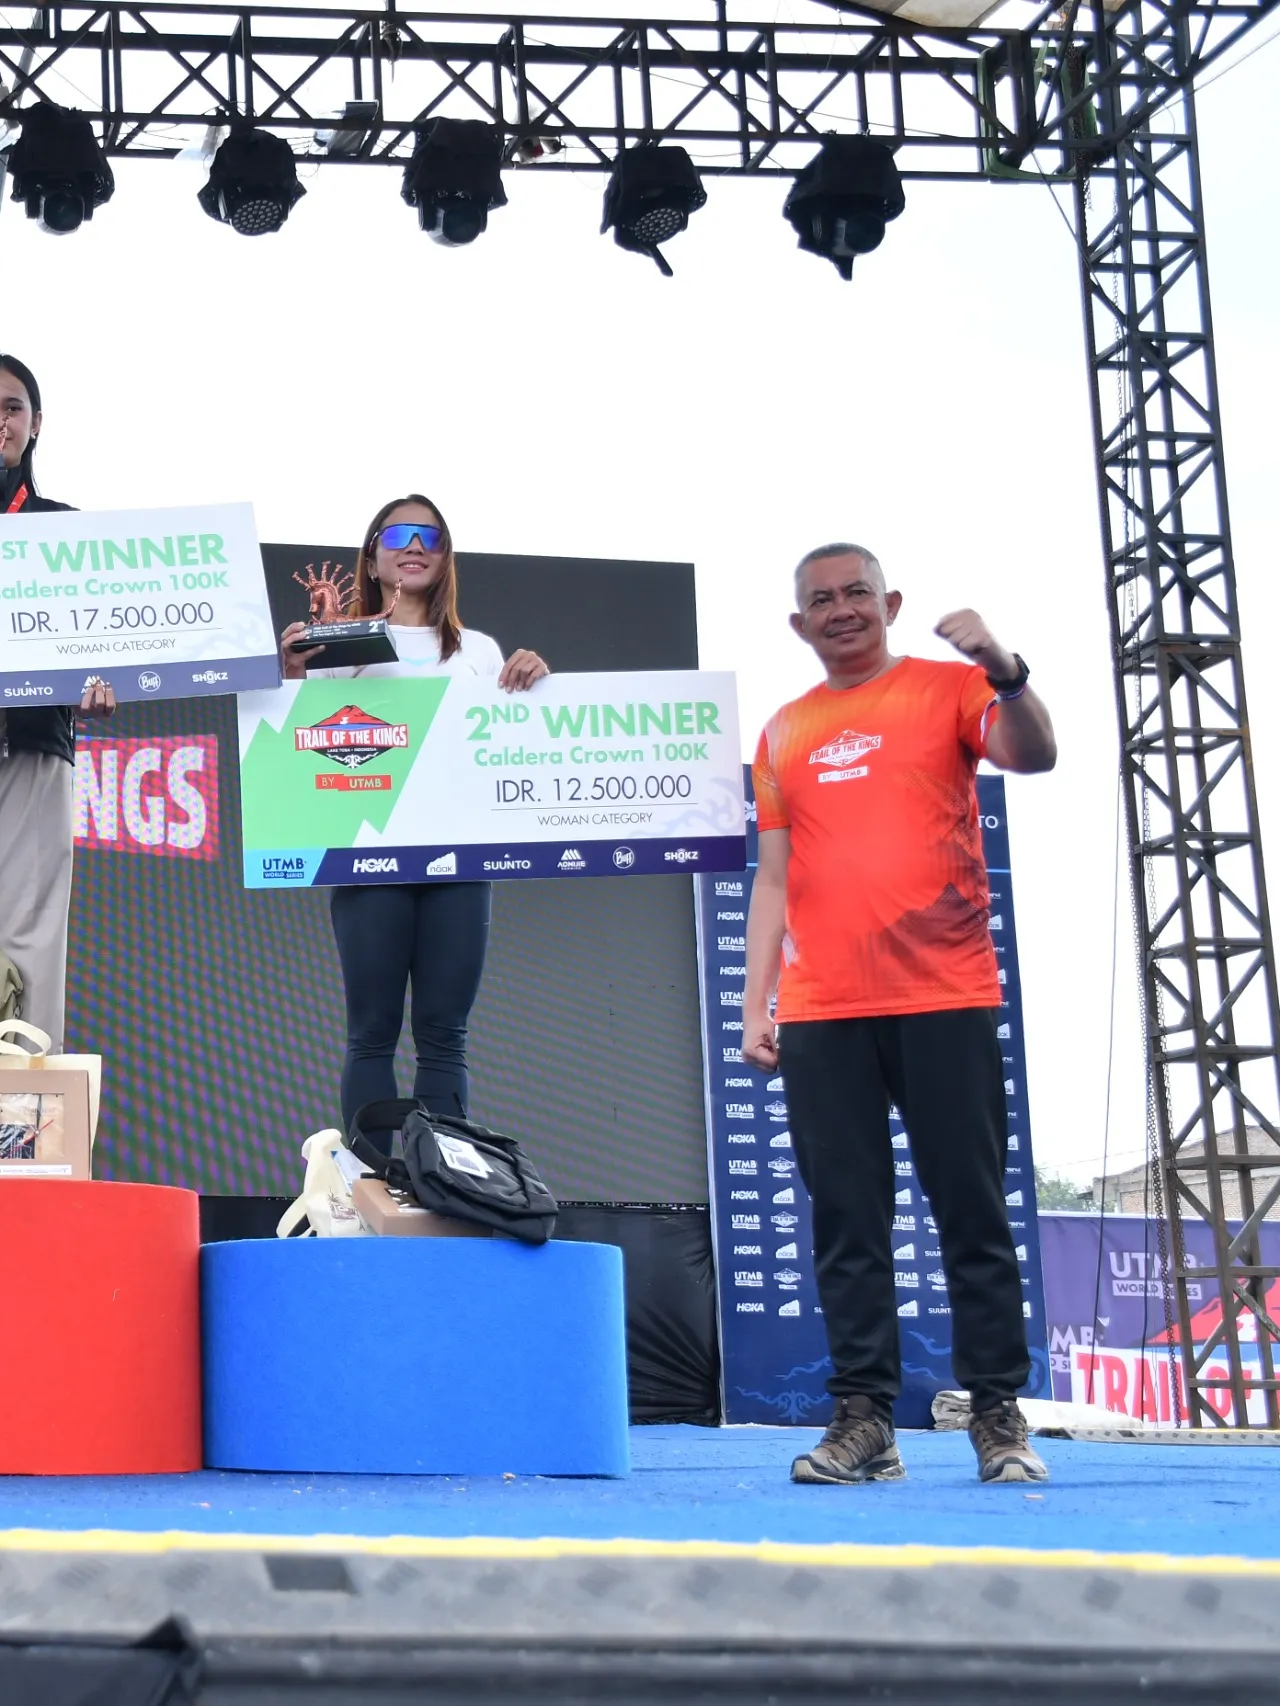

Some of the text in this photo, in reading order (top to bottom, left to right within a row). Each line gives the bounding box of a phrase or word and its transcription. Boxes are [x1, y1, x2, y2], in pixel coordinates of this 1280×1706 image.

[37, 533, 229, 573] WINNER
[84, 577, 162, 596] Crown
[170, 571, 230, 591] 100K
[11, 601, 214, 634] IDR. 17.500.000
[56, 638, 176, 655] WOMAN CATEGORY
[192, 671, 228, 684] SHOKZ
[4, 685, 54, 699] SUUNTO
[465, 701, 722, 741] 2ND WINNER
[296, 726, 407, 749] TRAIL OF THE KINGS
[474, 742, 709, 767] Caldera Crown 100K
[811, 737, 880, 763] TRAIL OF THE KINGS
[322, 777, 382, 788] BY UTMB
[495, 774, 692, 803] IDR. 12.500.000
[73, 746, 206, 849] NGS
[537, 812, 653, 826] WOMAN CATEGORY
[664, 850, 699, 862] SHOKZ
[262, 857, 304, 870] UTMB
[352, 857, 399, 873] HOKA
[483, 859, 531, 871] SUUNTO
[715, 882, 742, 891] UTMB
[717, 912, 744, 920] HOKA
[718, 937, 745, 945] UTMB
[720, 967, 746, 975] HOKA
[725, 1078, 753, 1087] HOKA
[726, 1104, 754, 1112] UTMB
[728, 1134, 756, 1143] HOKA
[729, 1160, 757, 1168] UTMB
[731, 1191, 759, 1200] HOKA
[732, 1214, 760, 1223] UTMB
[734, 1246, 761, 1254] HOKA
[735, 1272, 763, 1280] UTMB
[1116, 1283, 1159, 1294] WORLD
[736, 1303, 764, 1312] HOKA
